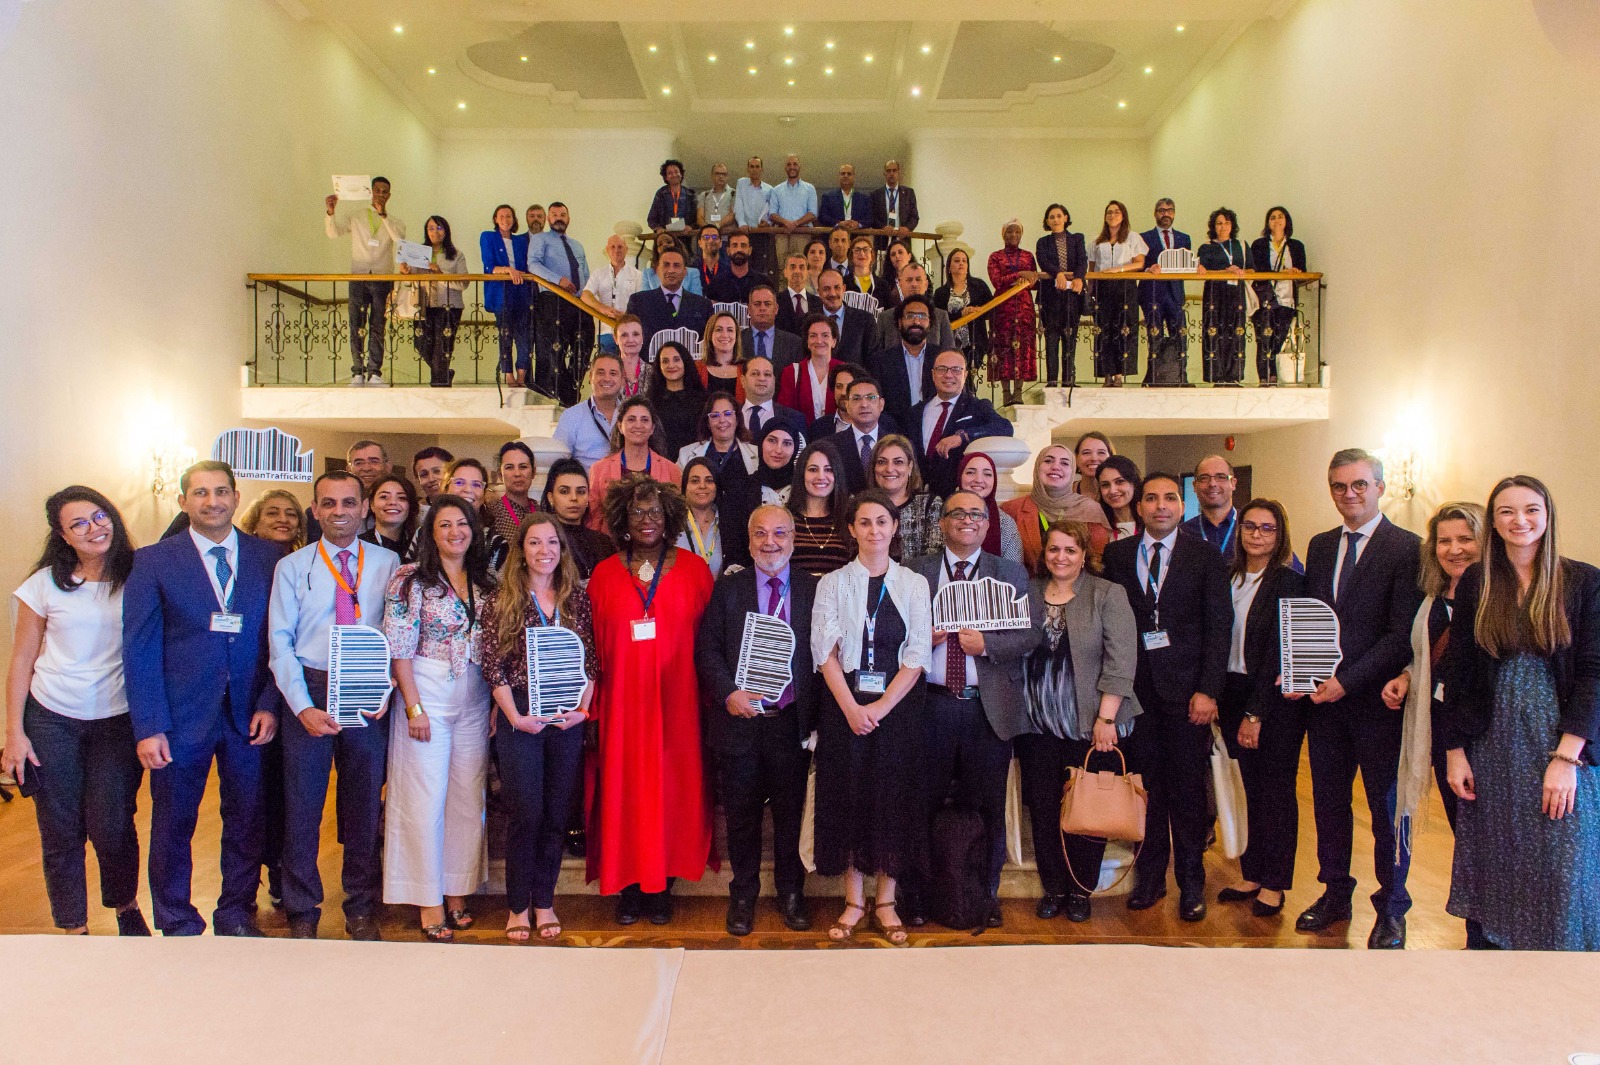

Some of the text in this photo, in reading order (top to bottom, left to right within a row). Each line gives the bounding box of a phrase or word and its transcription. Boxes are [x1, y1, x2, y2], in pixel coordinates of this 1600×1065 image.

[234, 470, 312, 482] HumanTrafficking
[737, 613, 755, 690] #EndHumanTraffic
[935, 620, 1030, 631] #EndHumanTrafficking
[1281, 600, 1291, 693] #EndHumanTrafficking
[329, 626, 340, 721] #EndHumanTraffickin
[527, 628, 539, 716] #EndHumanTrafficki
